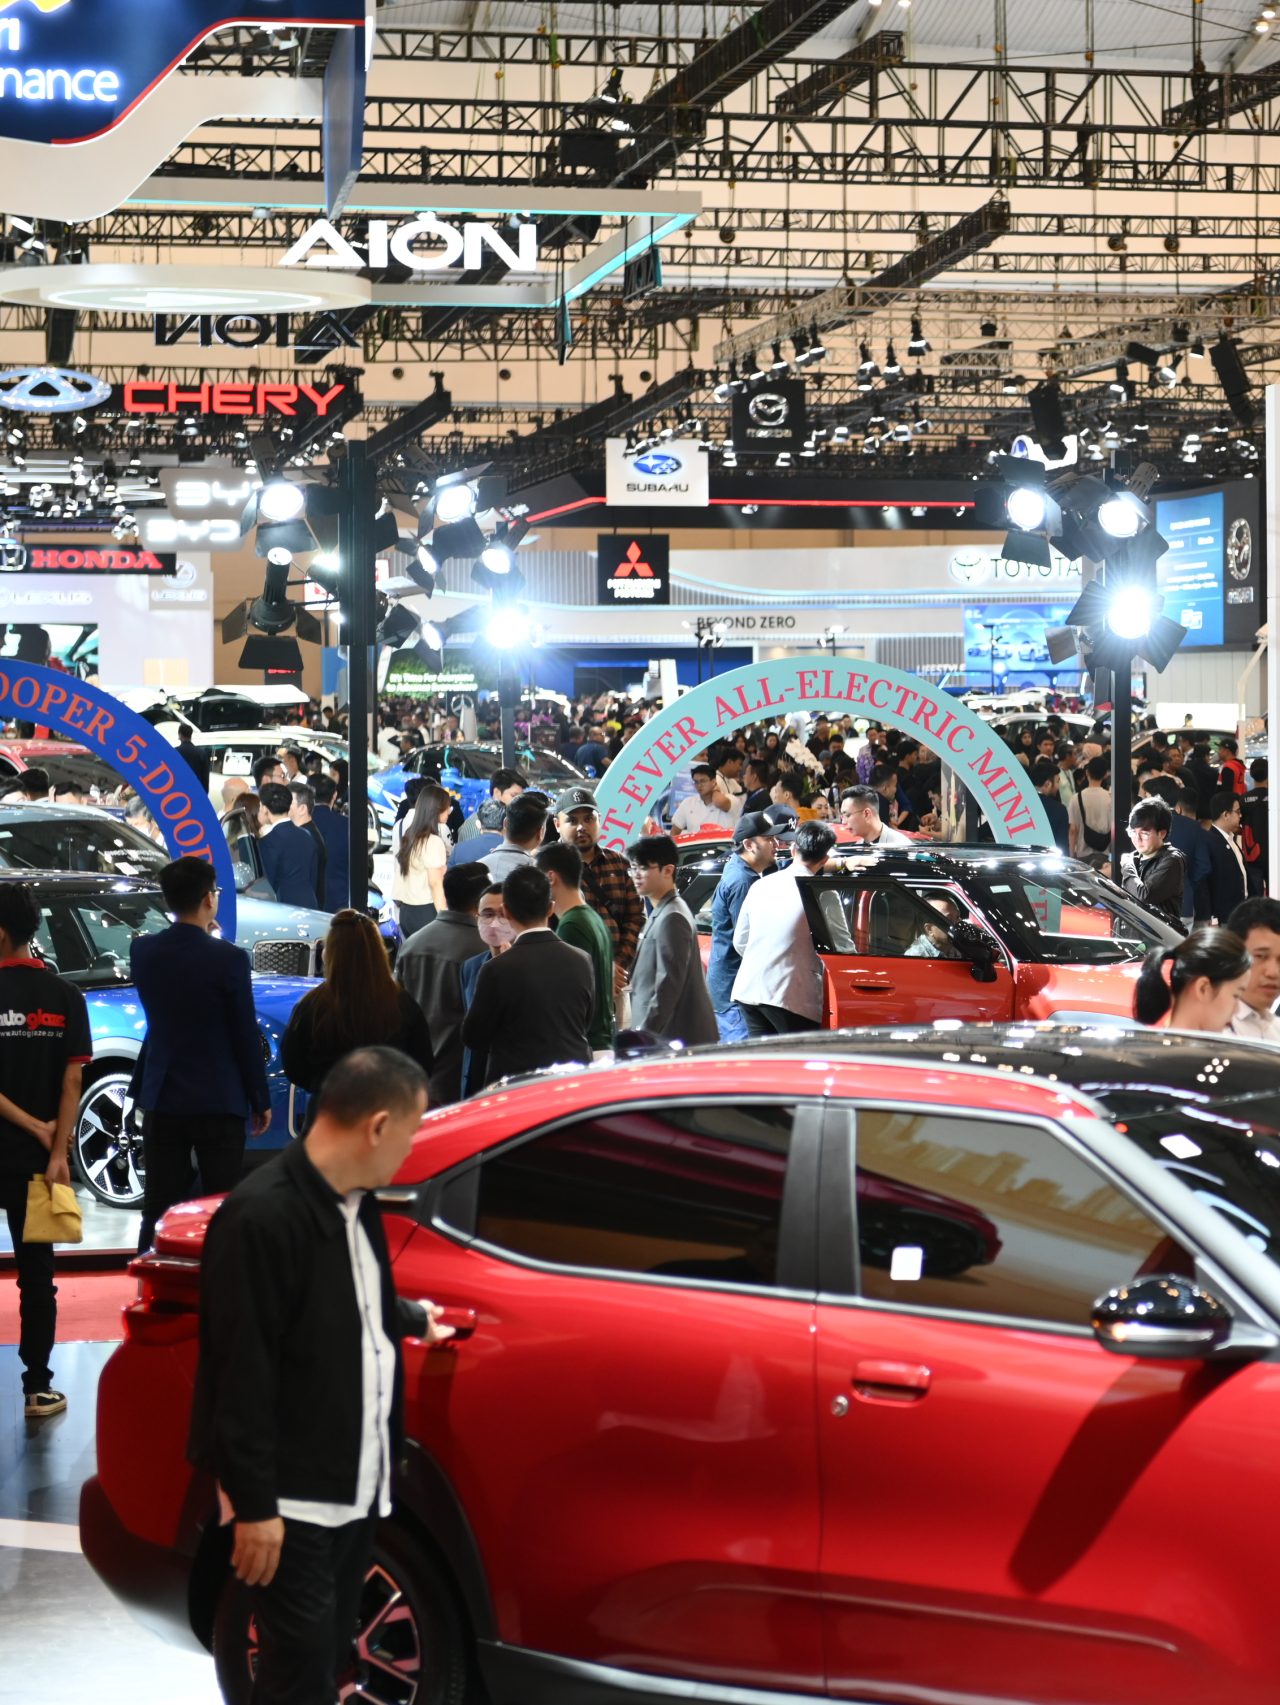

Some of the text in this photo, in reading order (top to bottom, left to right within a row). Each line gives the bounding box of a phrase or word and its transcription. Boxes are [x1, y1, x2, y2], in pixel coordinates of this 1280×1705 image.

[278, 218, 538, 271] AION
[124, 382, 346, 416] CHERY
[626, 483, 690, 493] SUBARU
[31, 549, 163, 570] HONDA
[990, 558, 1082, 577] TOYOTA
[697, 616, 796, 630] BEYOND ZERO
[916, 663, 966, 677] LIFESTYLE
[714, 670, 976, 755] ALL-ELECTRIC
[967, 746, 1037, 840] MINI
